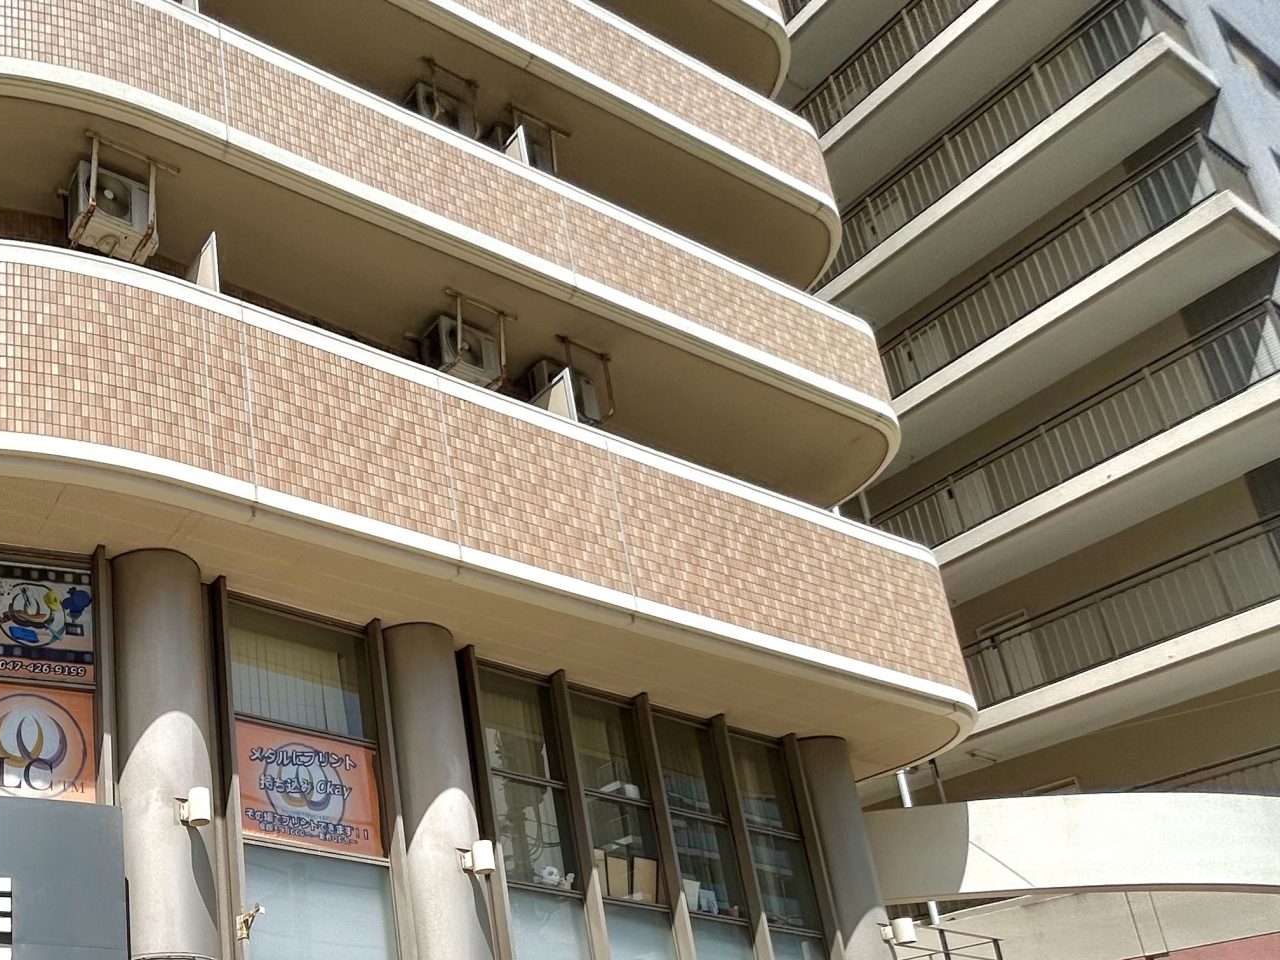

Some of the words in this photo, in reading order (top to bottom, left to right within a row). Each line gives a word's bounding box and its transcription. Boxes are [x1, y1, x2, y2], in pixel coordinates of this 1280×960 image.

[250, 748, 356, 771] メタルにプリント
[316, 781, 352, 800] Okay
